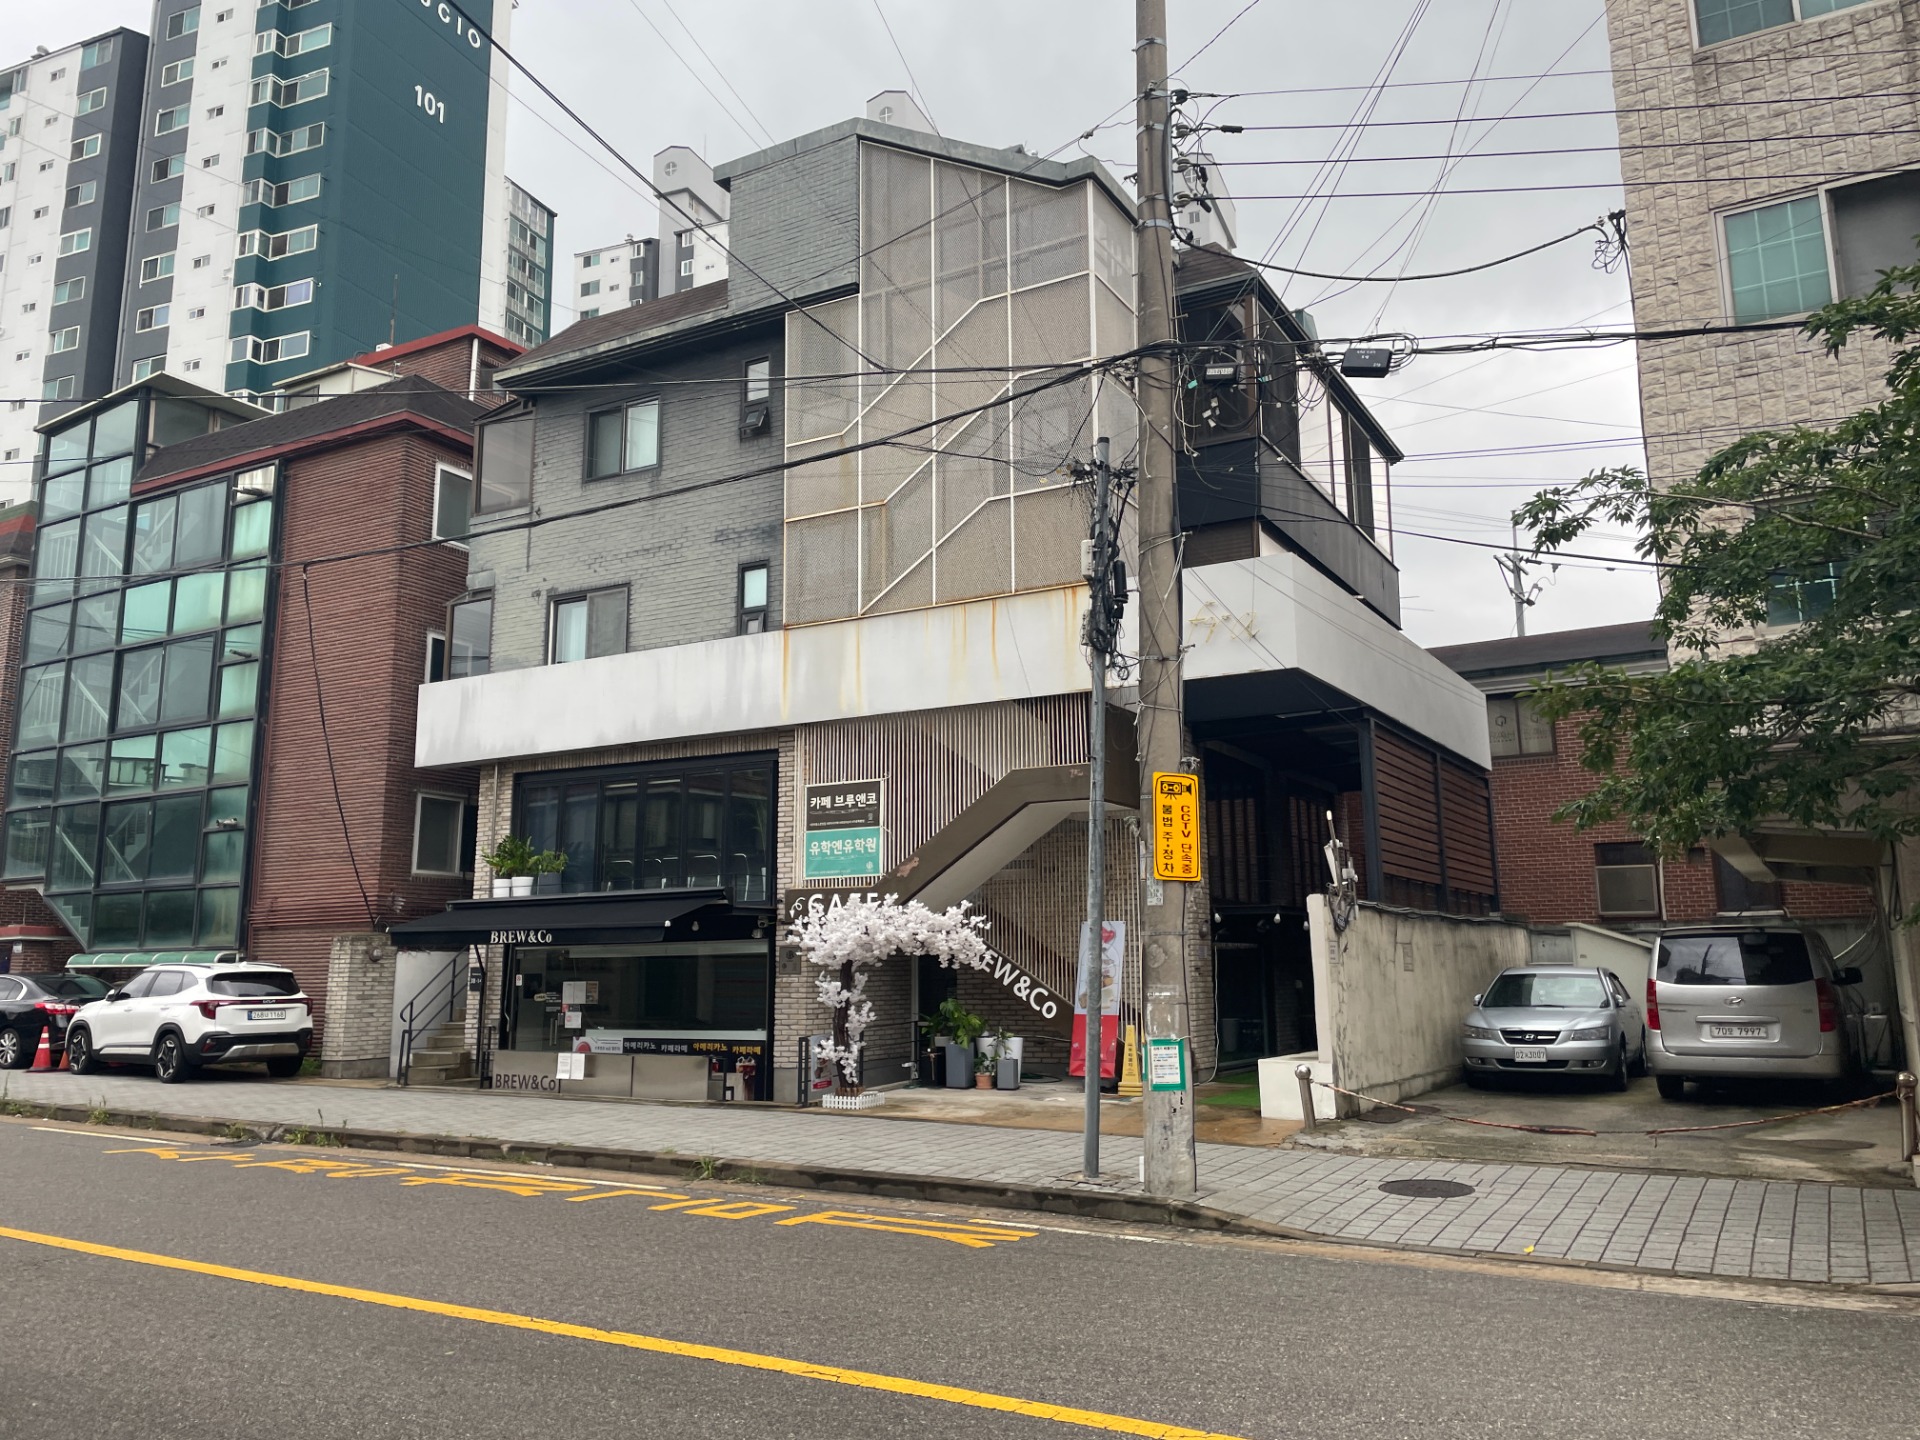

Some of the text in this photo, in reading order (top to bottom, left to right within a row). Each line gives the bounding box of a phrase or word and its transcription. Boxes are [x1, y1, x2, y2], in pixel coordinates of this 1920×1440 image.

[414, 84, 445, 124] 101
[810, 792, 878, 810] 카페 브루앤코
[1162, 804, 1173, 827] 불법
[1181, 805, 1192, 874] CCTV 단속중
[490, 929, 553, 944] BREW&Co
[1737, 1027, 1761, 1036] 7997
[624, 1041, 657, 1050] 아메리카노
[692, 1042, 728, 1052] 아메리카노
[495, 1073, 556, 1091] BREW&Co
